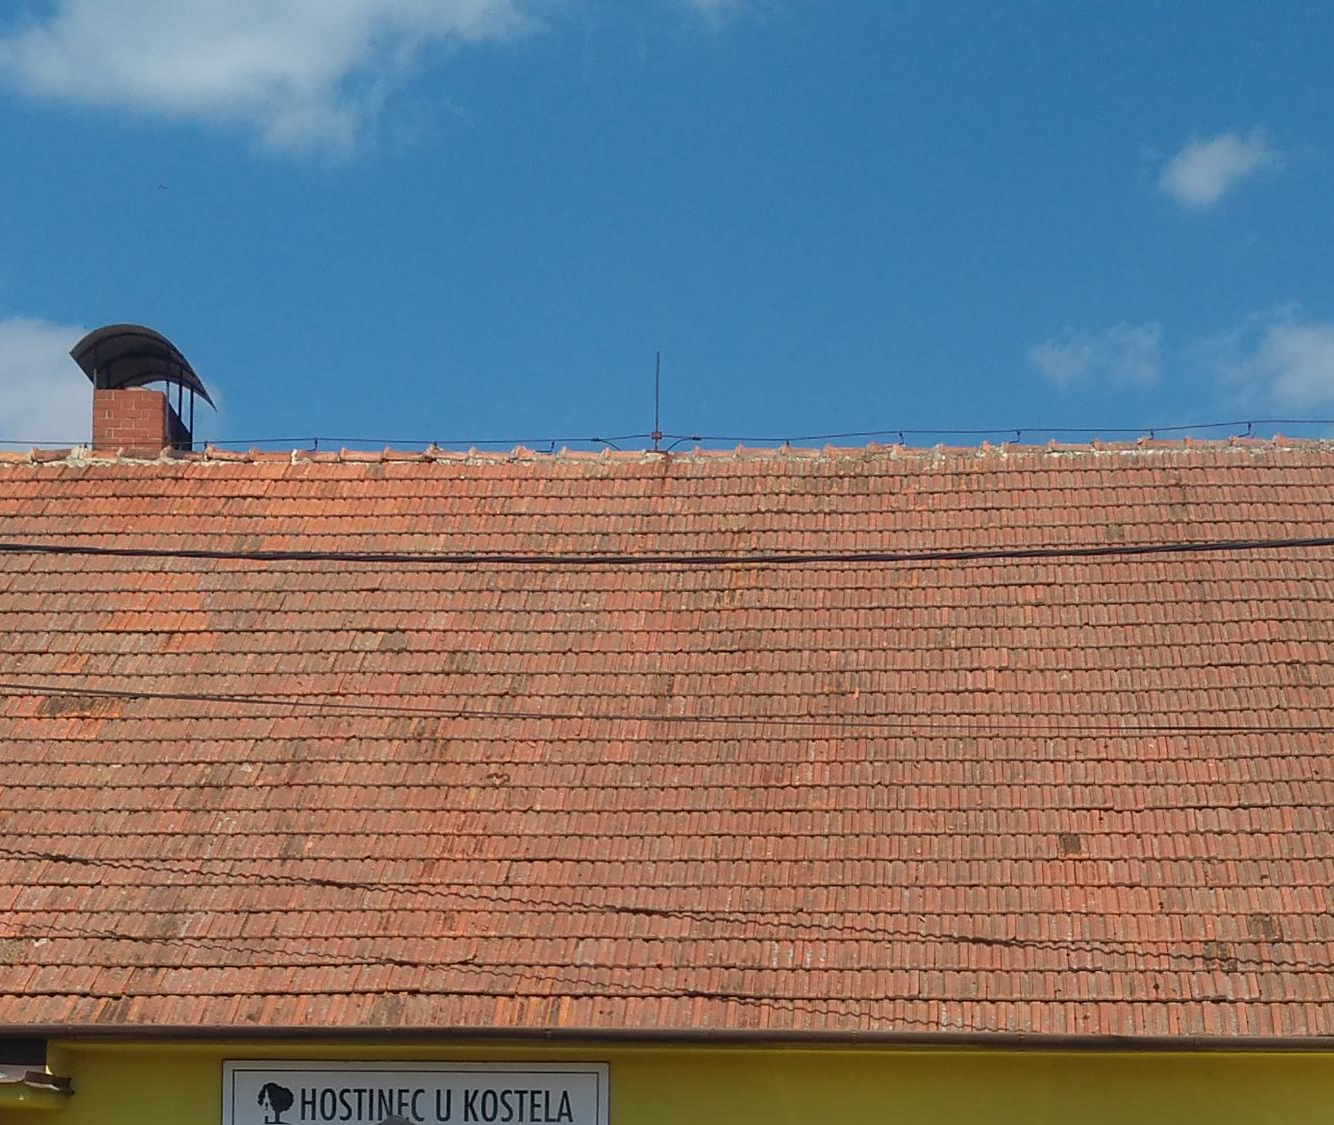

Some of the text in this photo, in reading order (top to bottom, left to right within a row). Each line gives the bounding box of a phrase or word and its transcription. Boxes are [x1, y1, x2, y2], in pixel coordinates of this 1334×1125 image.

[300, 1087, 573, 1123] HOSTINEC U KOSTELA
